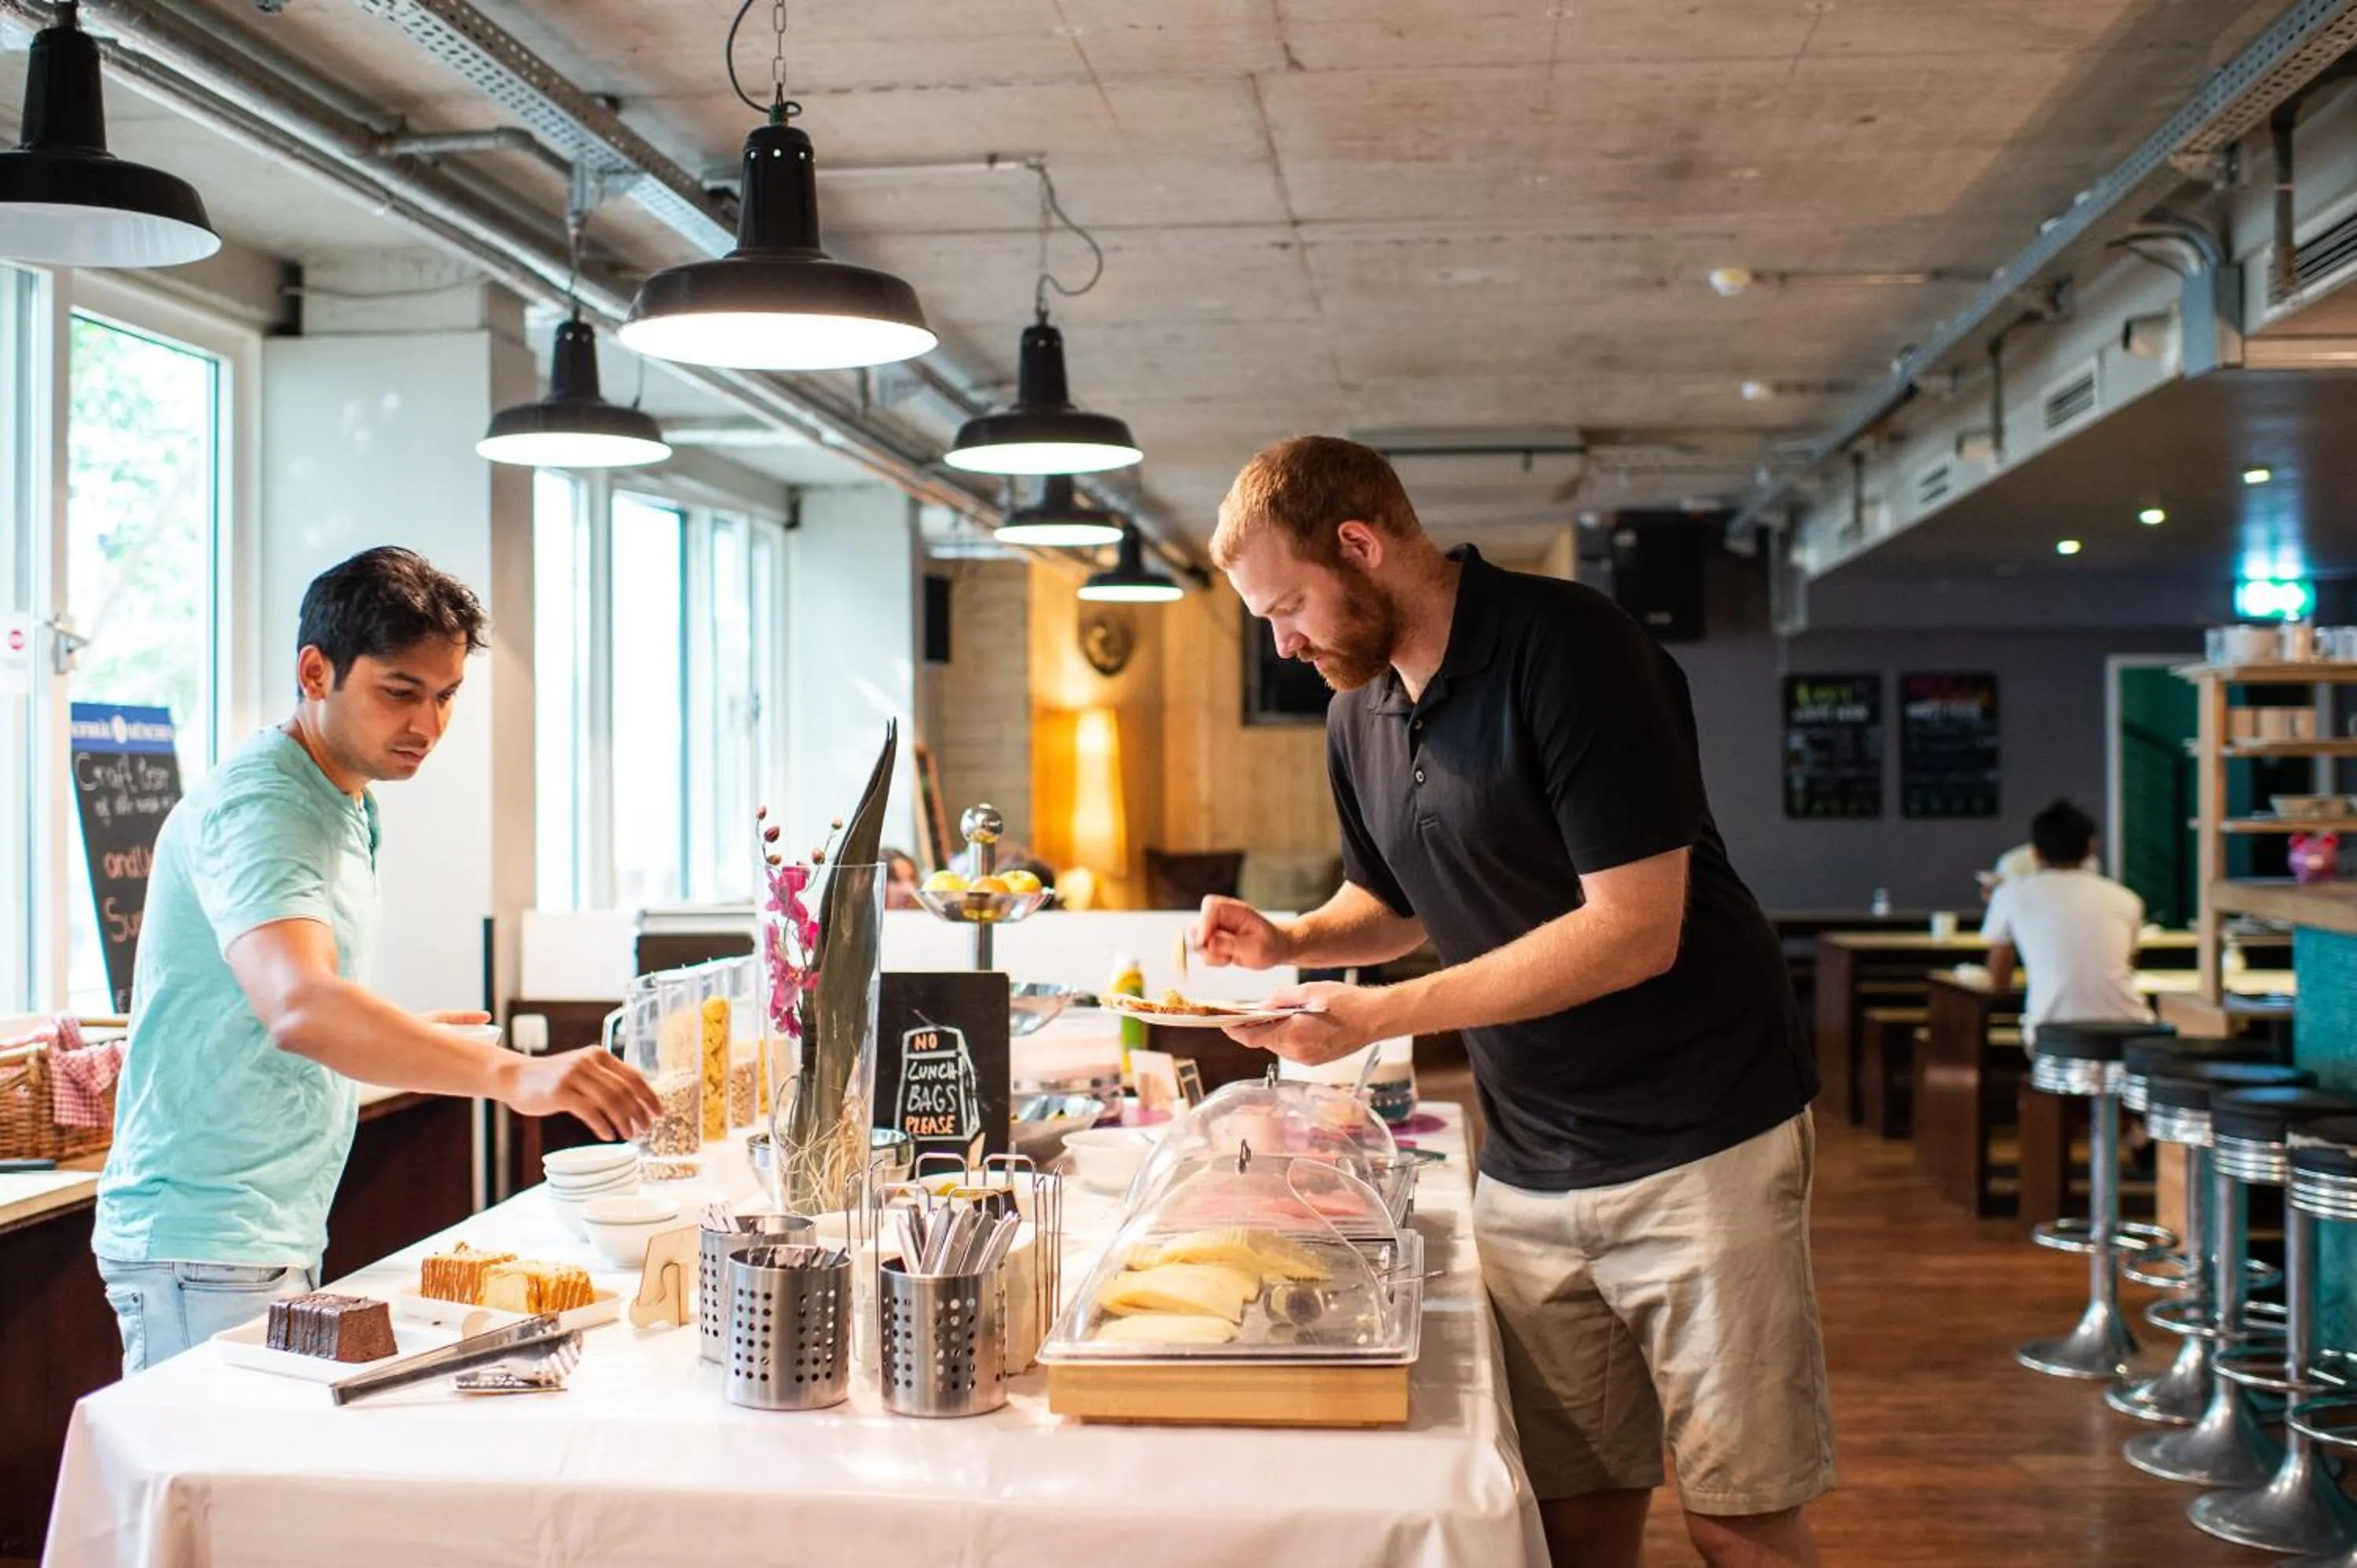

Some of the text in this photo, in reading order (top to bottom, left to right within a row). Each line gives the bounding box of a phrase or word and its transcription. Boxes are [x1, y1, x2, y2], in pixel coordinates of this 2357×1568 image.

[914, 1033, 938, 1051] NO
[907, 1061, 959, 1081] LUNCH
[907, 1084, 958, 1112] BAGS
[905, 1115, 956, 1135] PLEASE
